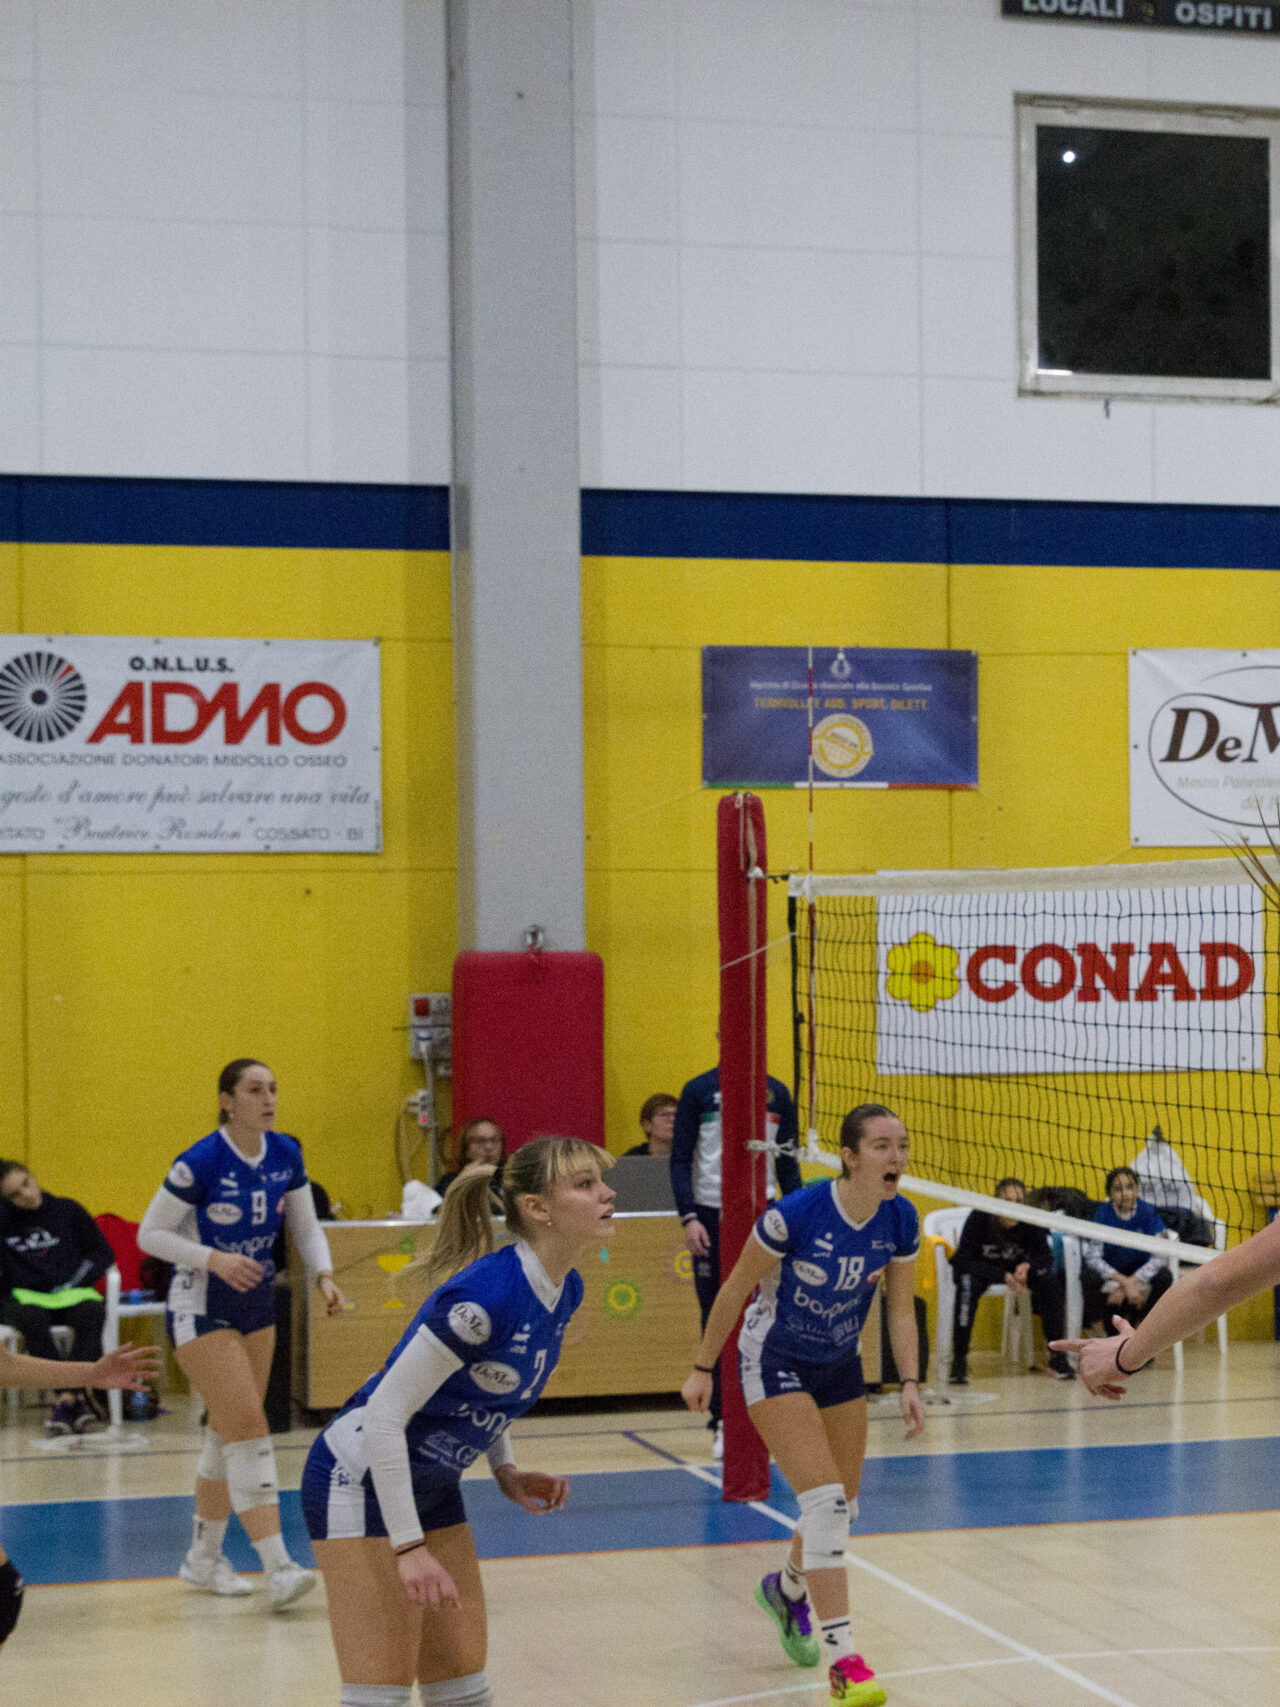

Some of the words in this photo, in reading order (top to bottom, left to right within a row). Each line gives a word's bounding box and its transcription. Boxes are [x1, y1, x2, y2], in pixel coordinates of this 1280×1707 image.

[1175, 1, 1272, 29] OSPITI
[129, 656, 234, 673] O.N.L.U.S.
[86, 681, 347, 745] ADMO
[121, 753, 208, 767] DONATORI
[213, 754, 289, 768] MIDOLLO
[294, 754, 348, 768] OSSEO
[966, 942, 1254, 1002] CONAD
[252, 1190, 267, 1225] 9
[833, 1256, 865, 1291] 18
